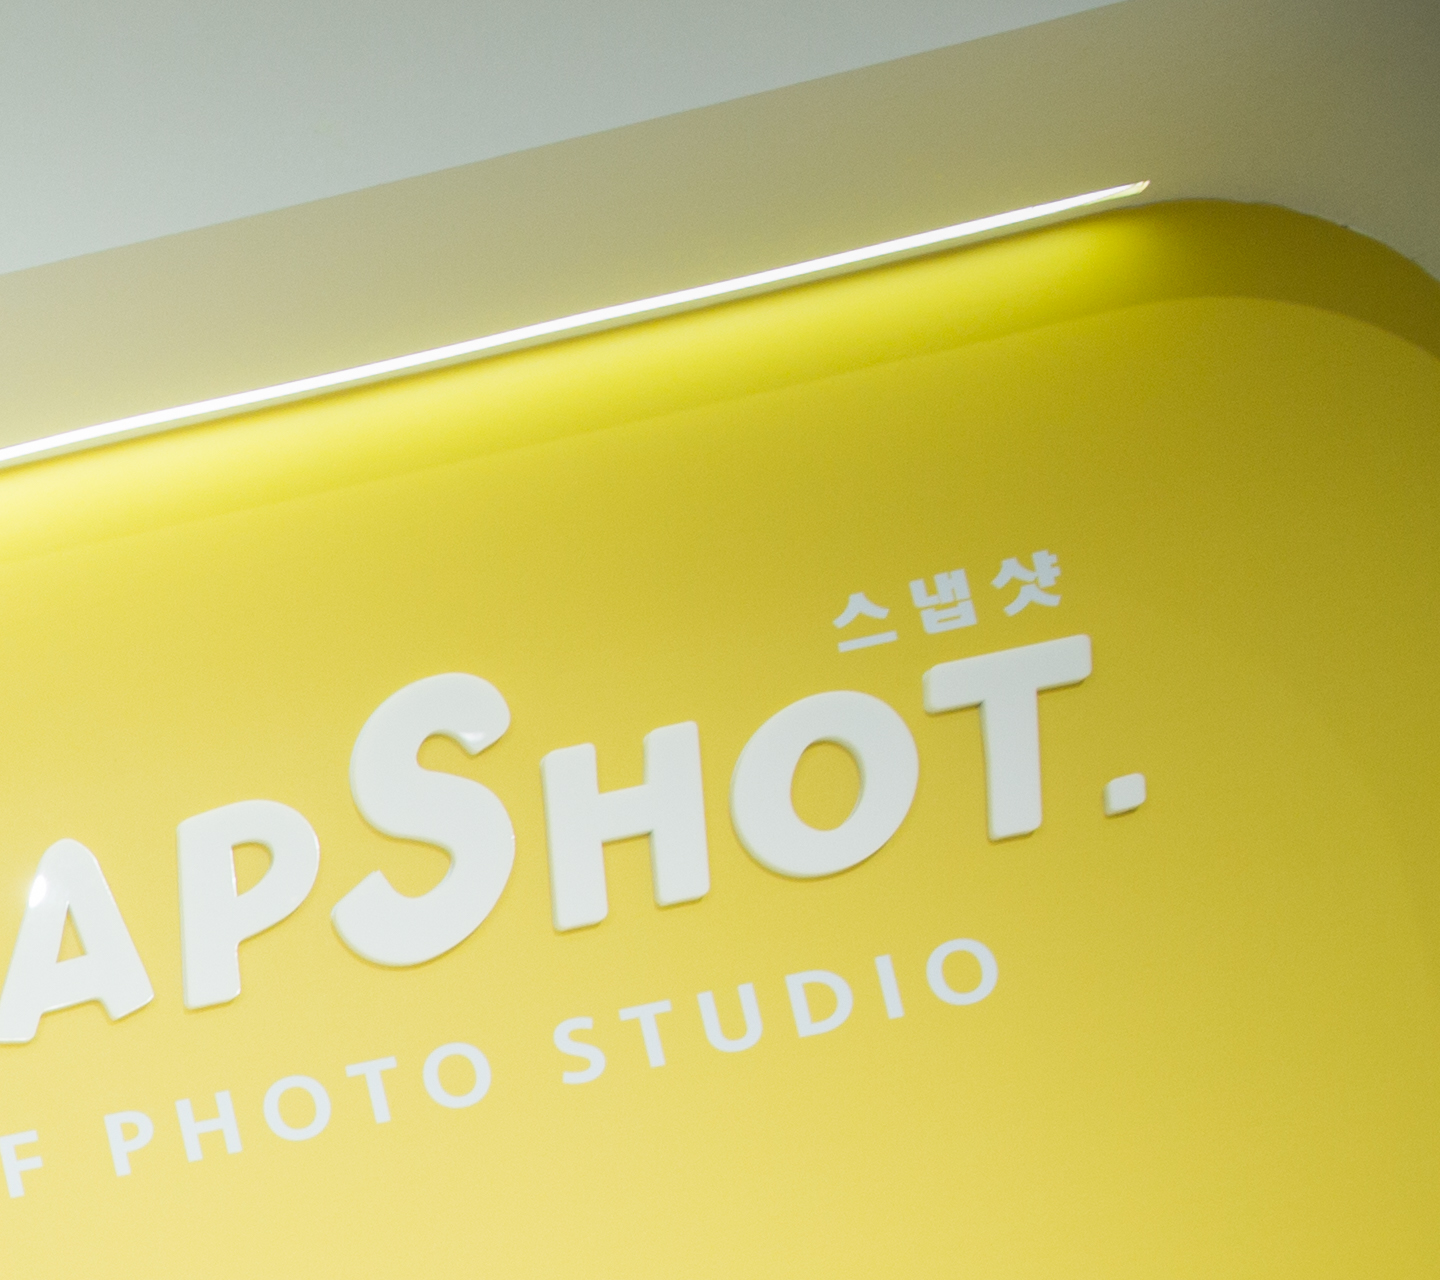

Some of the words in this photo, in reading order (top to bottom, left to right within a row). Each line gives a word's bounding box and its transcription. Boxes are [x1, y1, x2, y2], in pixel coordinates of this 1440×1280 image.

[832, 549, 1062, 653] 스냅샷
[102, 1040, 493, 1179] PHOTO
[551, 937, 1000, 1086] STUDIO
